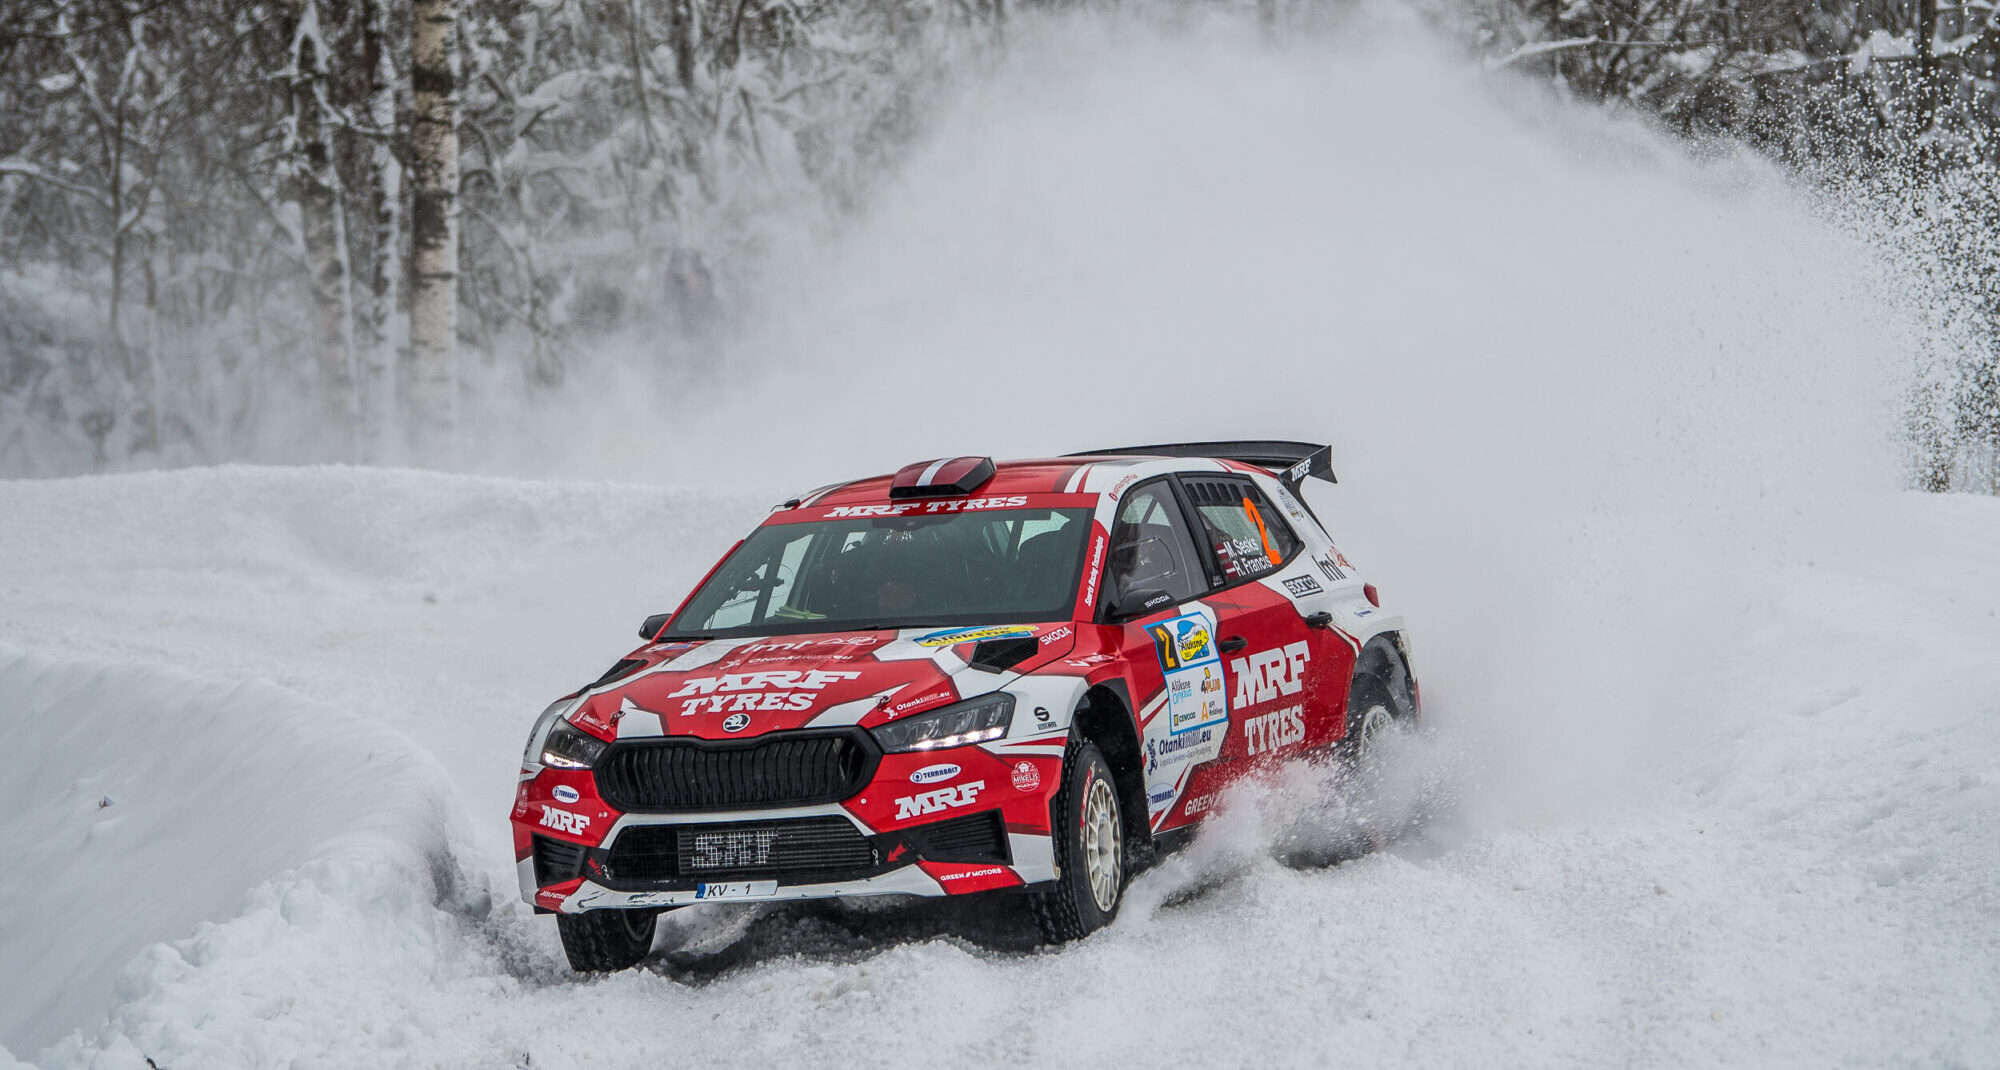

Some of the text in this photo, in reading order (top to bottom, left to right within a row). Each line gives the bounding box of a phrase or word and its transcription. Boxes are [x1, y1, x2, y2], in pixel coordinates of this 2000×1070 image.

[1290, 458, 1312, 482] MRF
[823, 496, 1027, 518] MRF TYRES
[1243, 497, 1282, 565] 2
[1223, 536, 1259, 558] M. Sesks
[1233, 561, 1246, 578] R.
[1155, 627, 1176, 668] 2
[667, 669, 862, 699] MRF
[1230, 640, 1310, 710] MRF
[680, 693, 817, 717] TYRES
[1245, 704, 1305, 756] TYRES
[895, 780, 985, 820] MRF
[1184, 793, 1214, 816] GREEN
[539, 805, 590, 836] MRF
[940, 868, 1002, 881] GREEN MOTORS
[707, 884, 728, 897] KV
